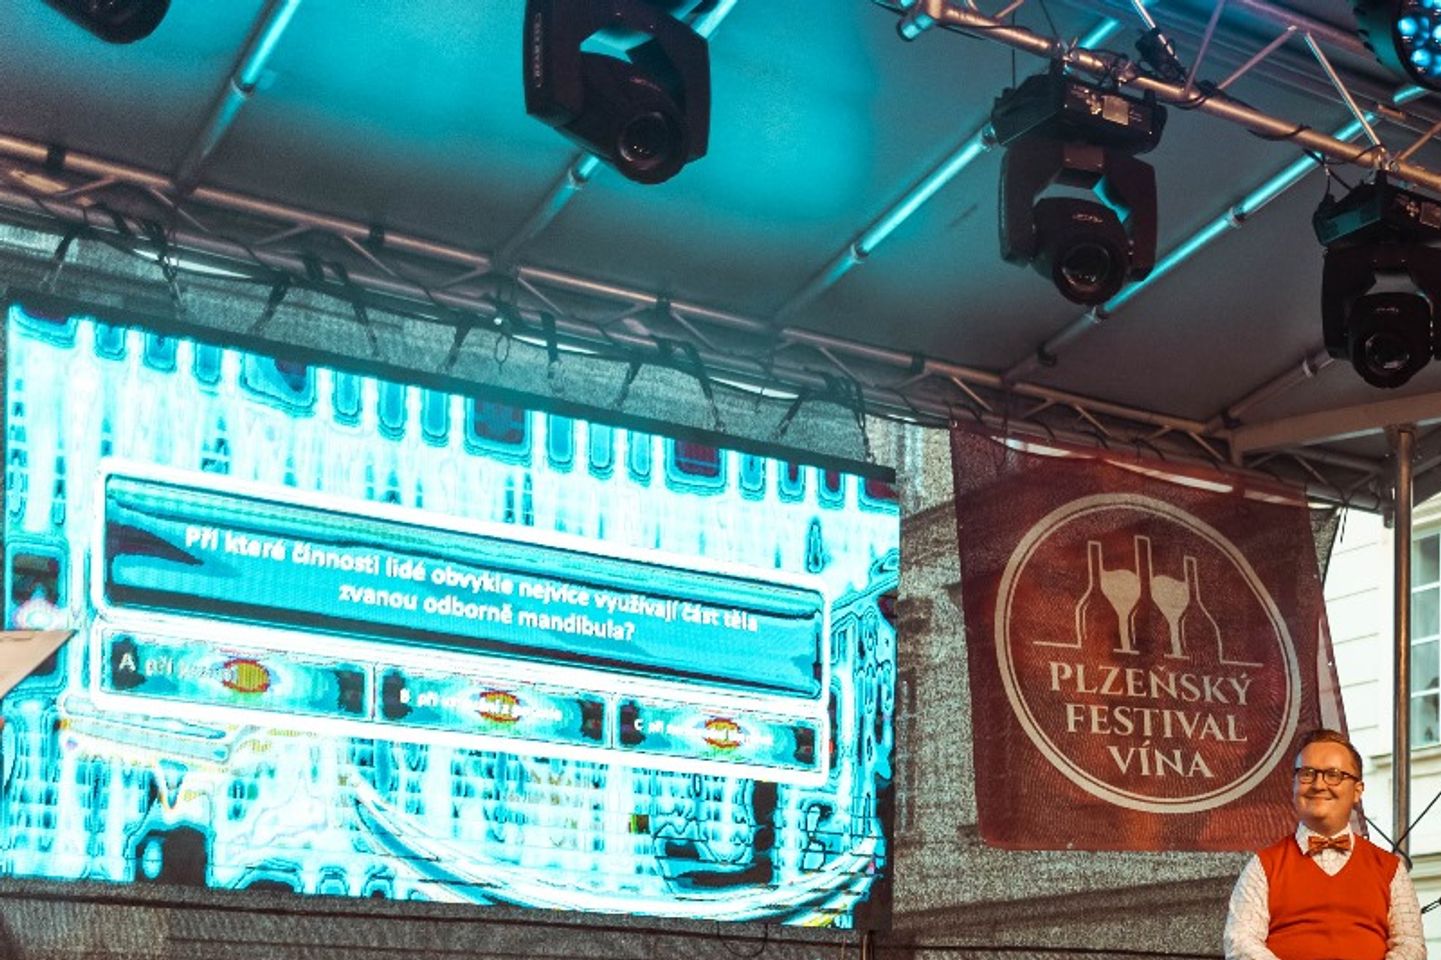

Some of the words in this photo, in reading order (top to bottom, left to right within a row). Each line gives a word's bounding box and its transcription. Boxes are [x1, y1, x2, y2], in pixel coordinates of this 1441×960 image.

[225, 530, 286, 561] které
[292, 540, 380, 577] činnosti
[385, 556, 426, 583] lidé
[431, 566, 514, 595] obvykle
[519, 580, 590, 607] nejvíce
[594, 589, 679, 622] využívají
[681, 601, 720, 626] část
[723, 608, 759, 633] těla
[338, 583, 418, 611] zvanou
[423, 595, 513, 624] odborně
[518, 608, 636, 642] mandibula?
[1049, 661, 1252, 706] PLZEŇSKÝ
[1065, 703, 1248, 742] FESTIVAL
[1106, 740, 1215, 778] VÍNA
